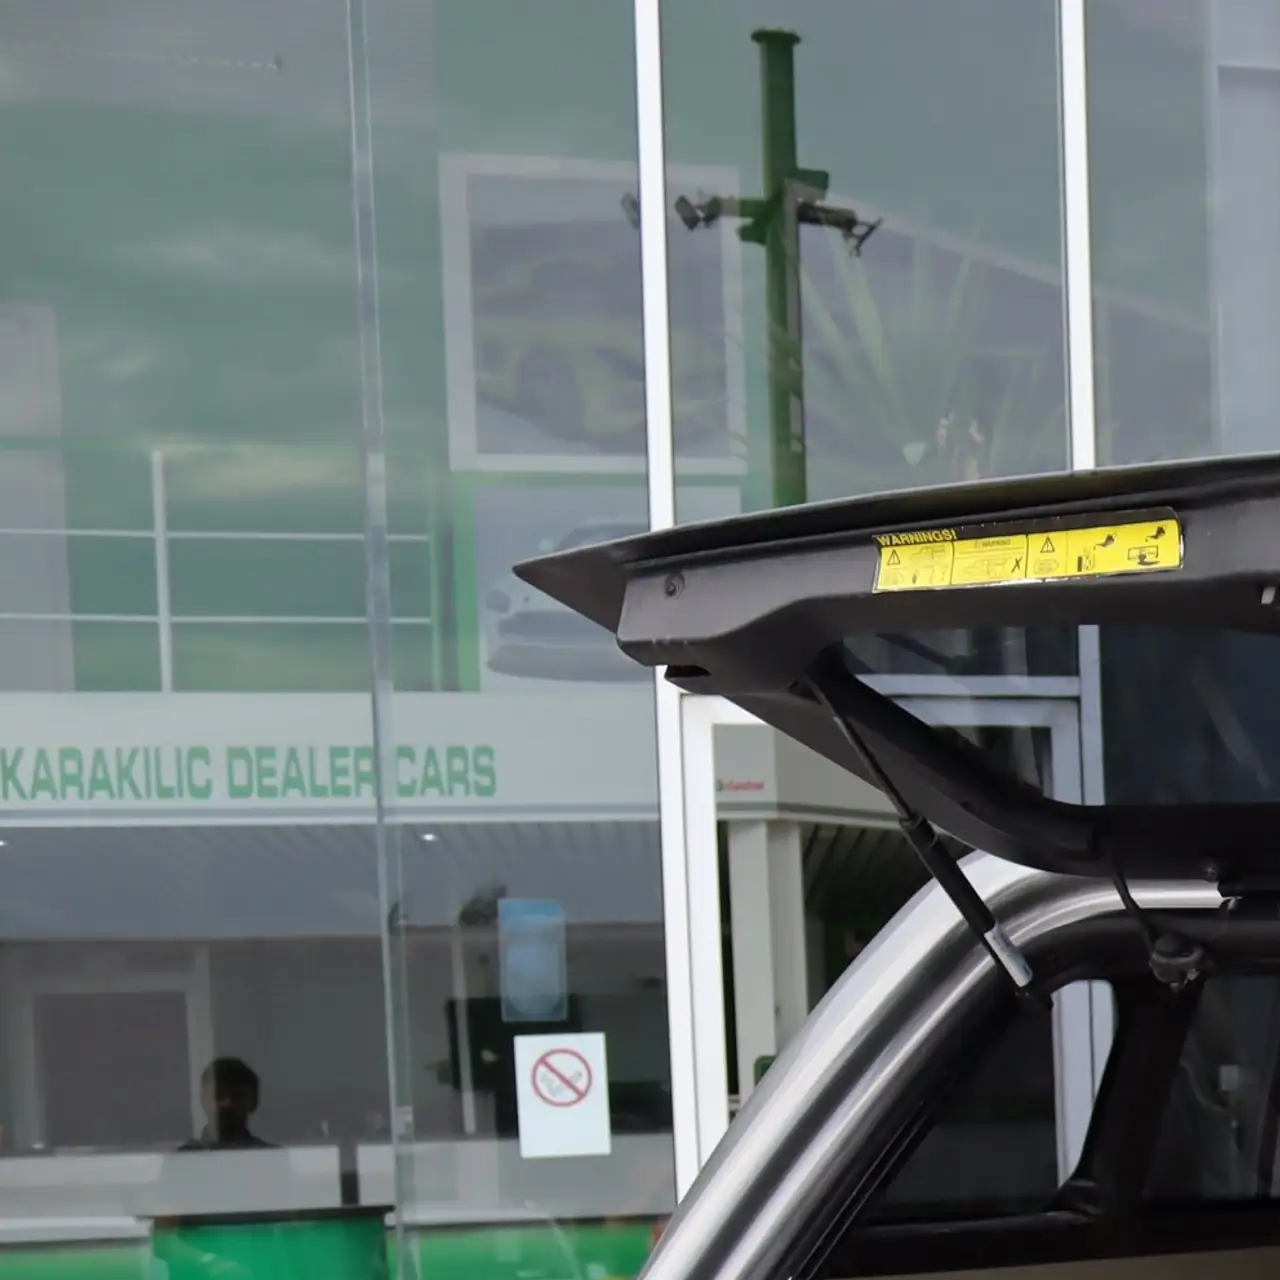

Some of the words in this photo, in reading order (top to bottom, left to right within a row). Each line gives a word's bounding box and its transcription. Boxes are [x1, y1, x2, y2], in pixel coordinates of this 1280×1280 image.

[876, 528, 958, 547] WARNINGS!
[1, 746, 213, 800] KARAKILIC
[226, 745, 378, 799] DEALER
[395, 744, 497, 798] CARS
